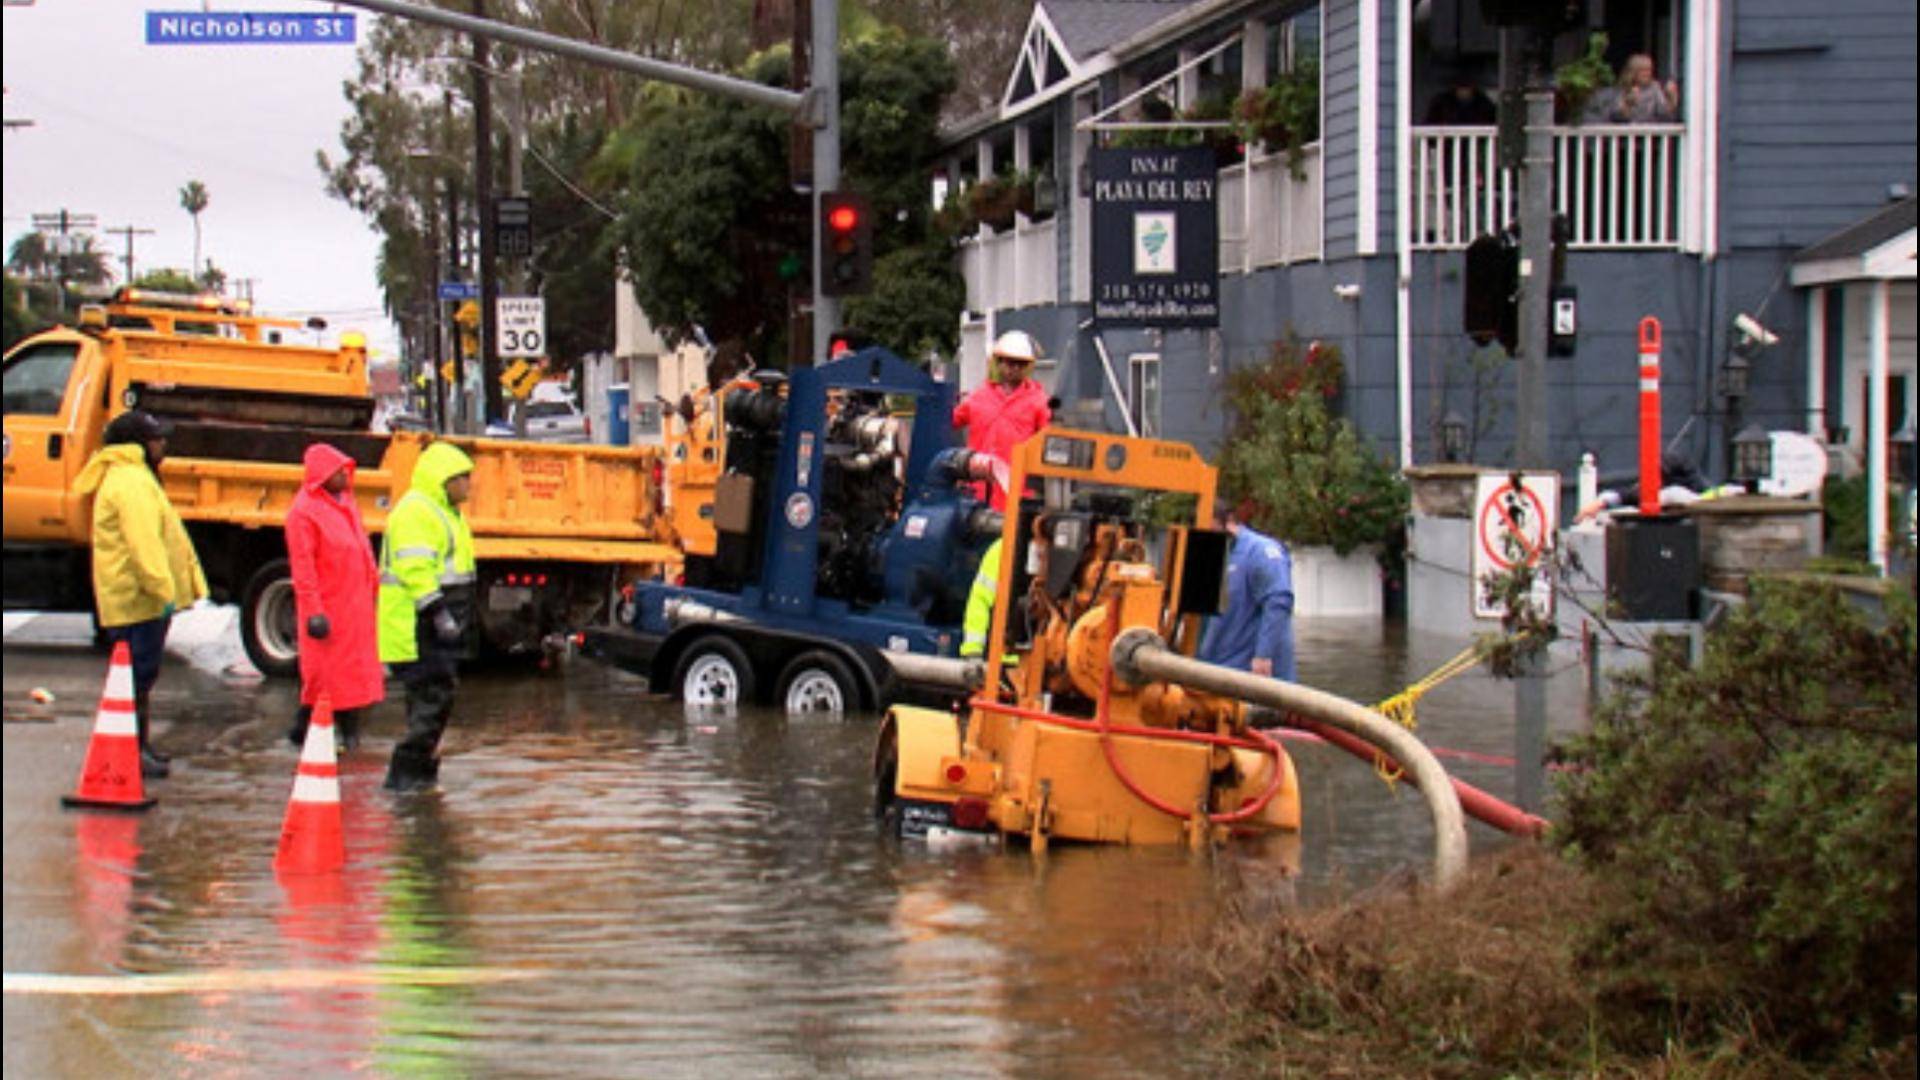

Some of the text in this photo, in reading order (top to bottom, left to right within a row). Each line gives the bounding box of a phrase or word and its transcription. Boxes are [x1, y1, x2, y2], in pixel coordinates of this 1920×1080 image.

[160, 18, 345, 37] Nicholson St
[1131, 157, 1178, 174] INN AT
[1095, 181, 1213, 201] PLAYA DEL REY
[501, 302, 540, 313] SPEED
[504, 315, 536, 326] LIMIT
[504, 330, 540, 351] 30
